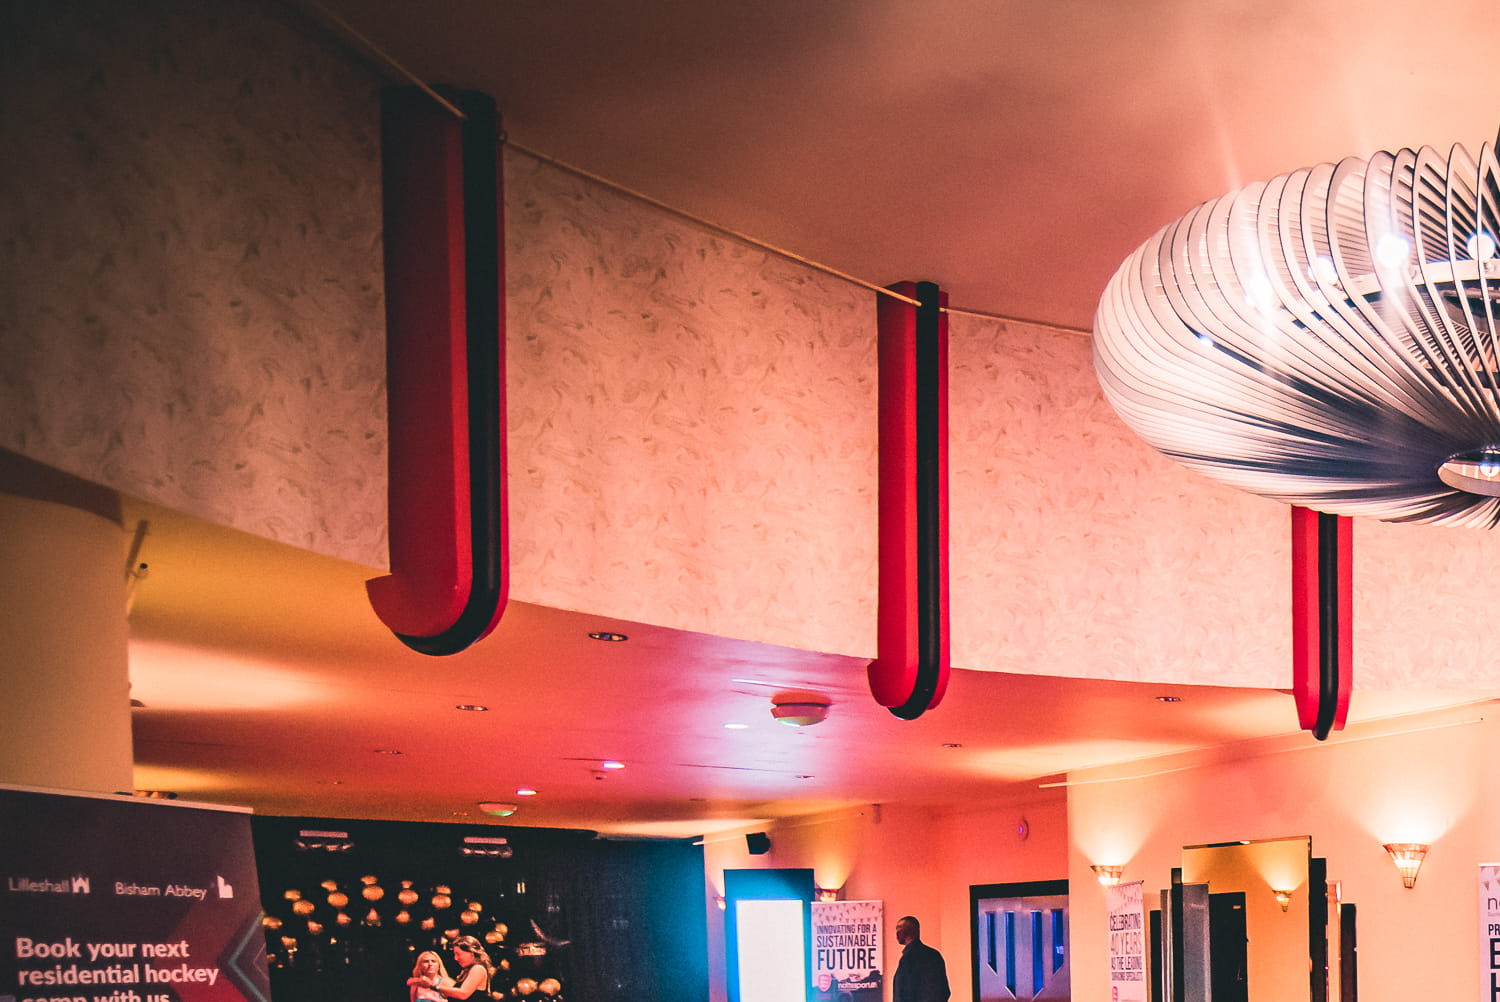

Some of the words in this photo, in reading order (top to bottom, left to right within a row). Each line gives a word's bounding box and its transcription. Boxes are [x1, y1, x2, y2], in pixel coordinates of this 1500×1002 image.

[8, 876, 71, 894] Lilleshall
[114, 881, 161, 897] Bisham
[164, 883, 208, 901] Abbey
[816, 924, 855, 934] INNOVATING
[857, 924, 870, 933] FOR
[872, 923, 877, 933] A
[16, 937, 82, 958] Book
[86, 942, 137, 962] your
[142, 940, 190, 958] next
[816, 934, 876, 948] SUSTAINABLE
[817, 948, 877, 970] FUTURE
[18, 963, 140, 985] residential
[144, 963, 220, 986] hockey
